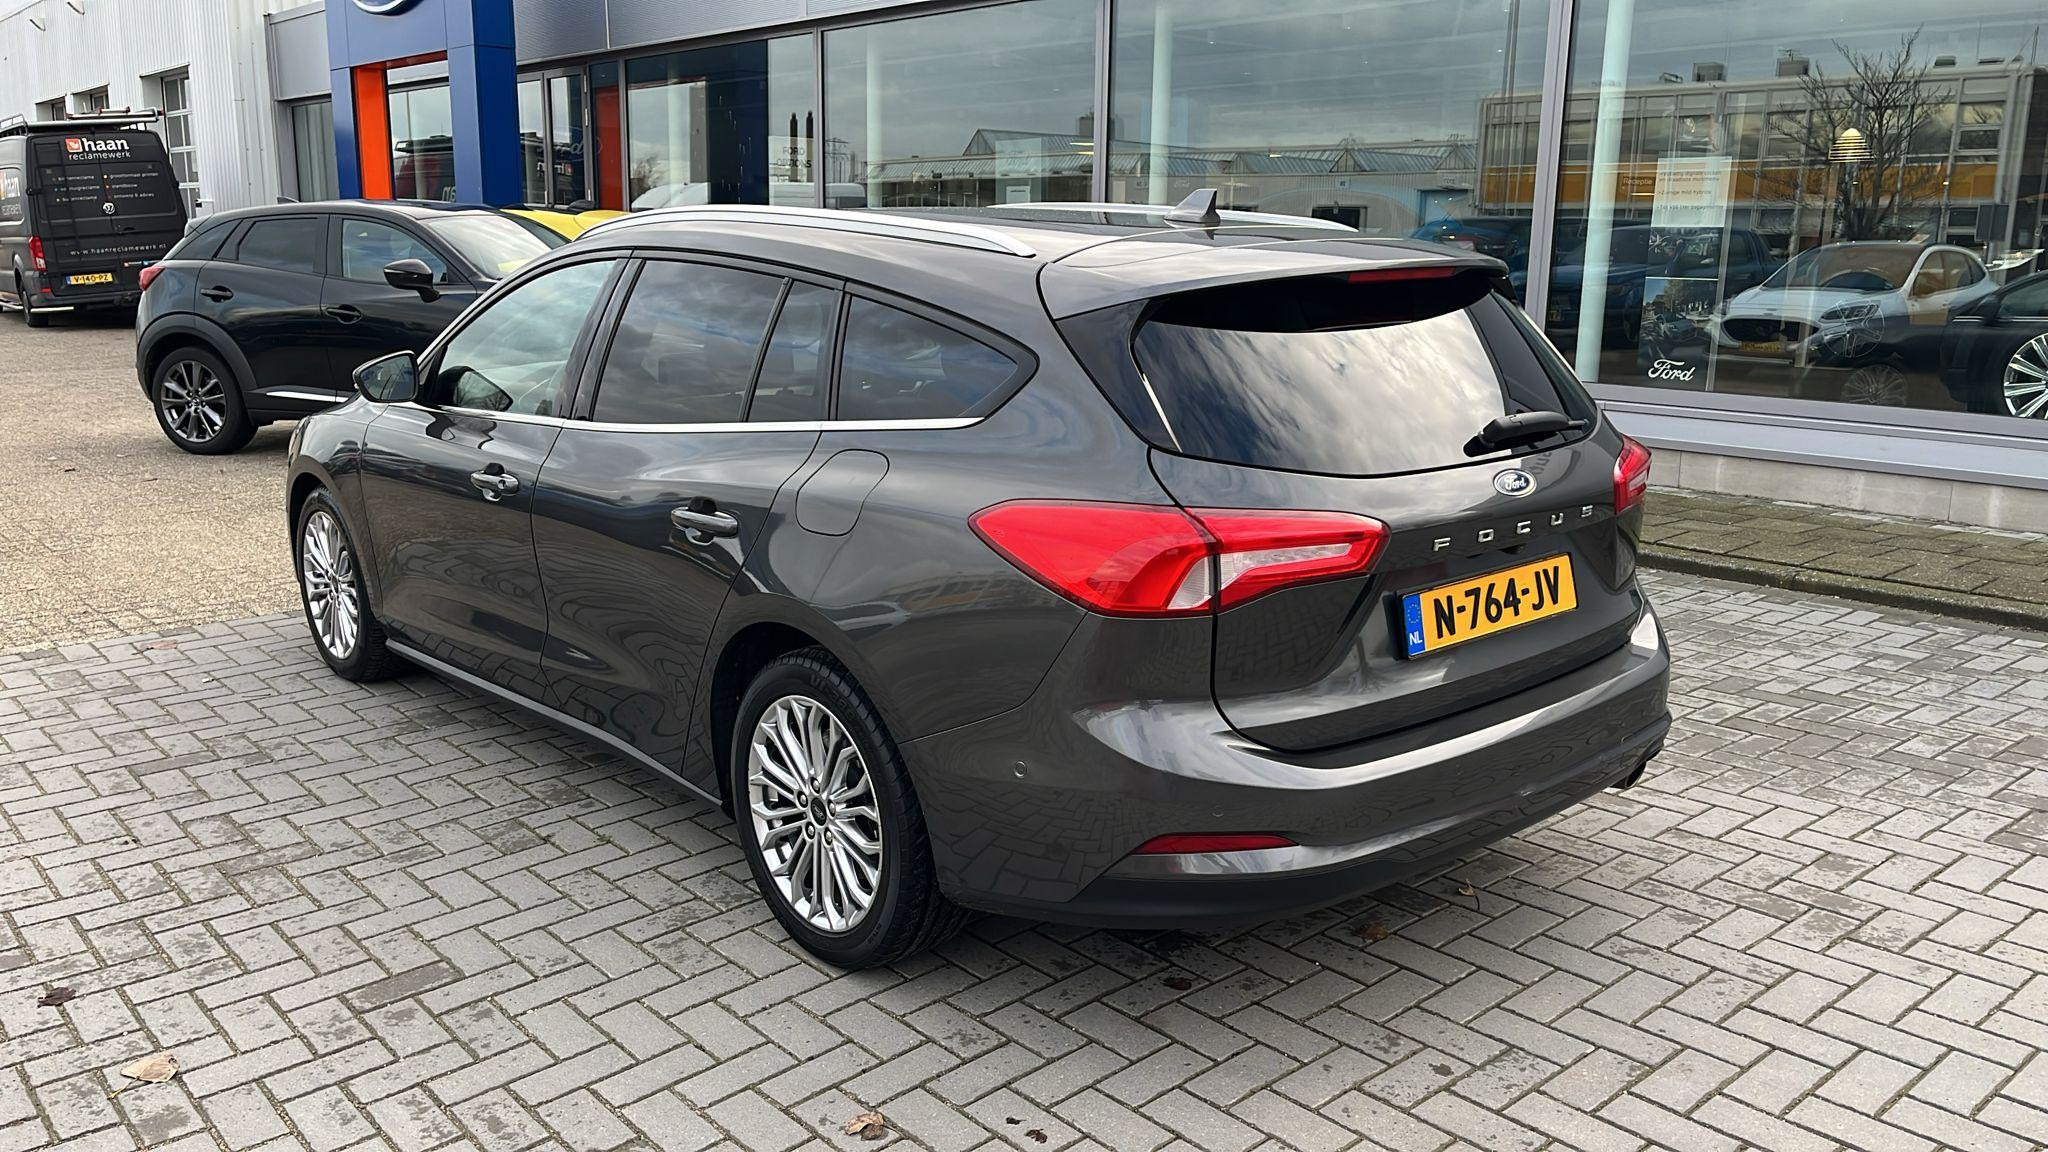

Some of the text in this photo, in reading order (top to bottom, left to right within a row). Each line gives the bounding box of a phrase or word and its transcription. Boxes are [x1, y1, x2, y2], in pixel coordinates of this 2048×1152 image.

[81, 137, 130, 151] haan
[783, 146, 805, 156] FORD
[69, 151, 131, 160] reclamewerk
[74, 273, 109, 283] V-140-PZ
[1648, 359, 1696, 381] Ford
[1433, 505, 1593, 551] FOCUS
[1433, 565, 1560, 639] N-764-JV
[1408, 632, 1423, 646] NL
